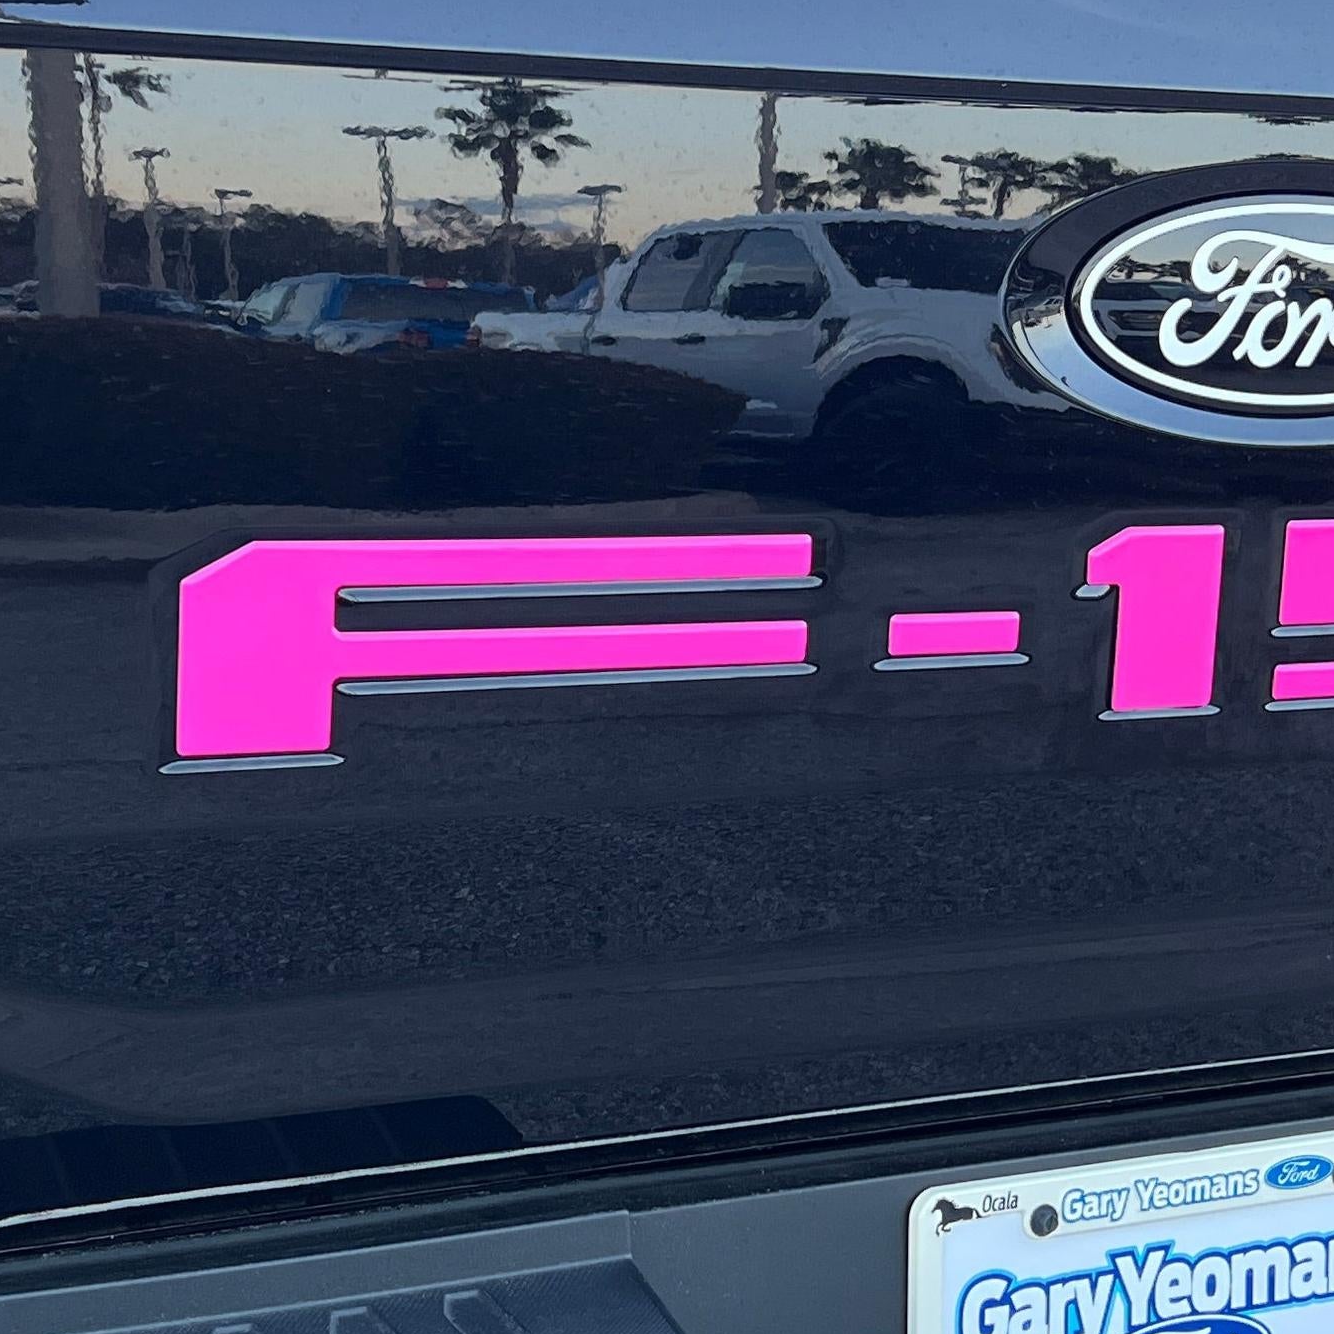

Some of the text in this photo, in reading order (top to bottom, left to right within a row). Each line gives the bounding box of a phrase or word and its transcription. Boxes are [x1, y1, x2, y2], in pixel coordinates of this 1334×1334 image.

[981, 1190, 1019, 1214] Ocala
[1061, 1160, 1320, 1223] Gary Yeomans Ford
